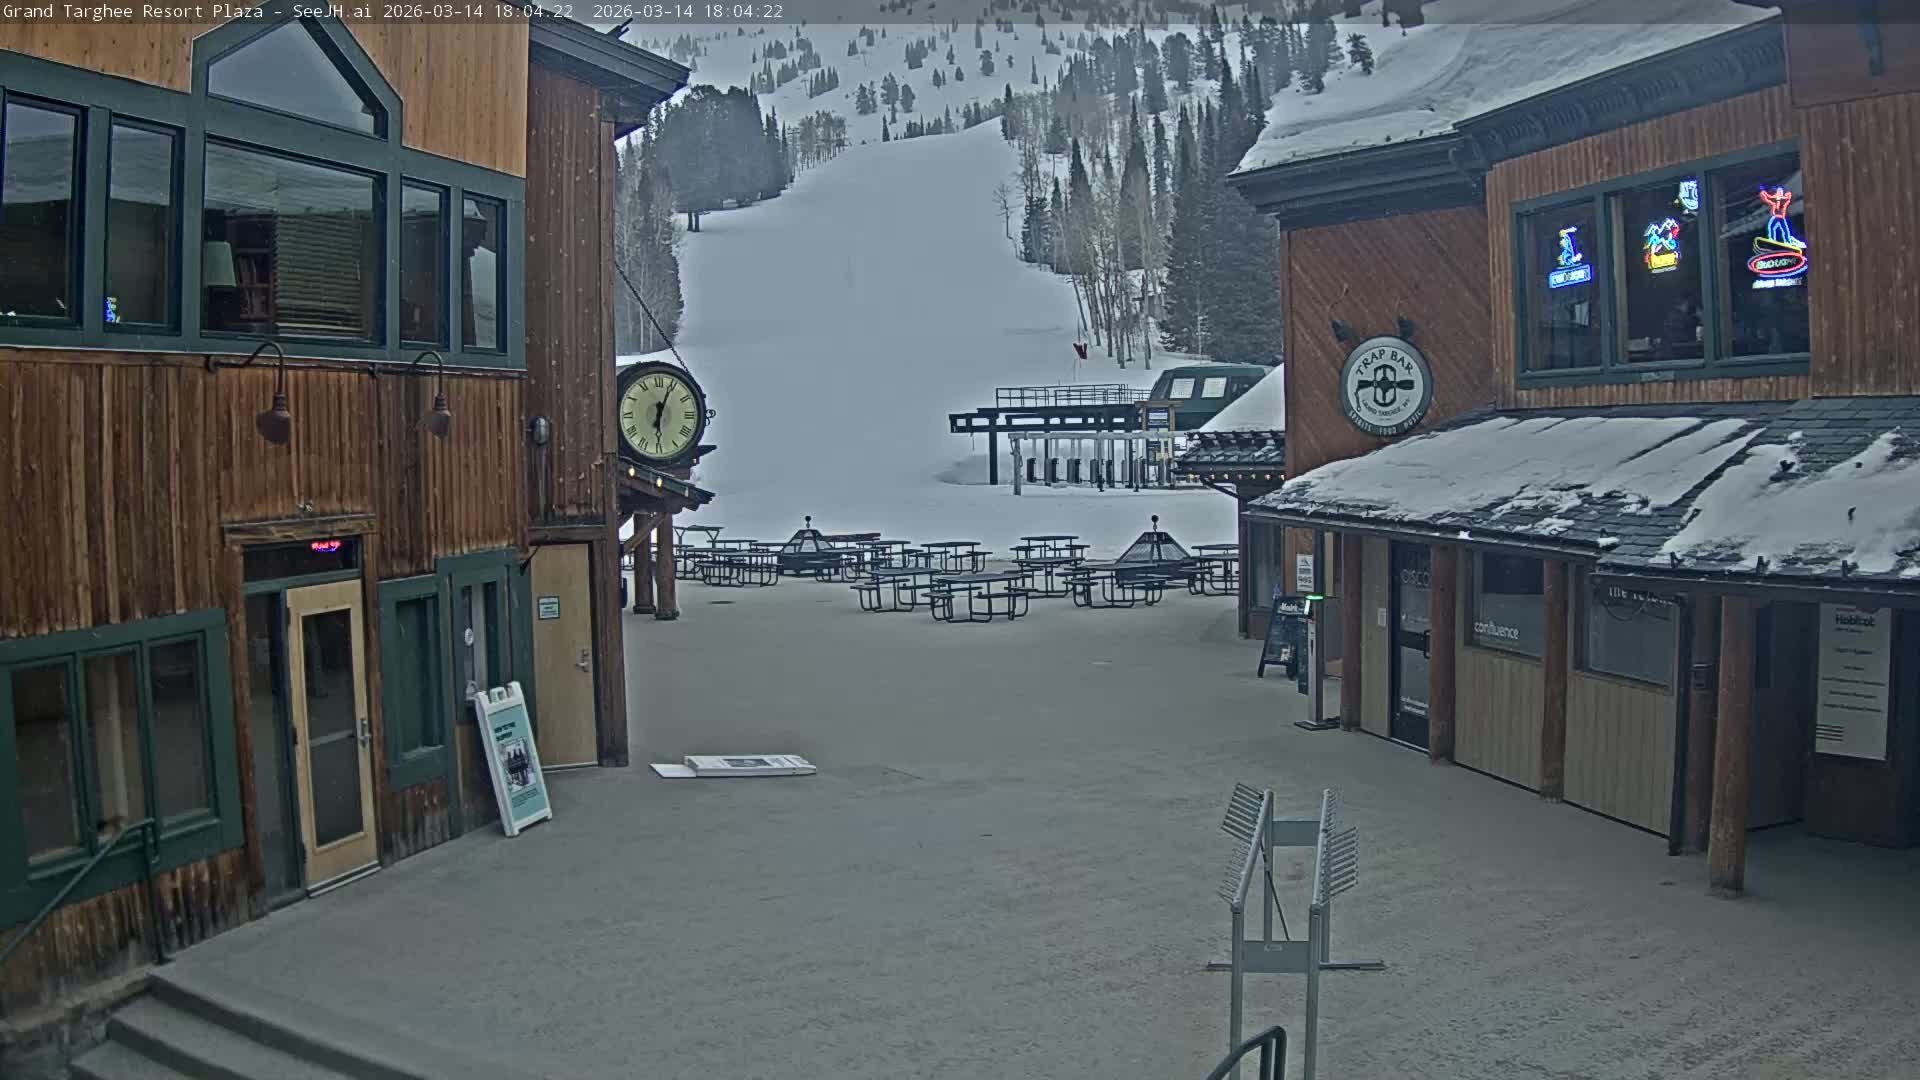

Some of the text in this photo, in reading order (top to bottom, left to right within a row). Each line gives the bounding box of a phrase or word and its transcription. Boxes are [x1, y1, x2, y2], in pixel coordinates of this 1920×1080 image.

[1356, 349, 1414, 376] TRAP BAR
[1379, 426, 1397, 435] FOOD
[1404, 410, 1423, 429] MUSIC
[1474, 620, 1519, 640] confluence
